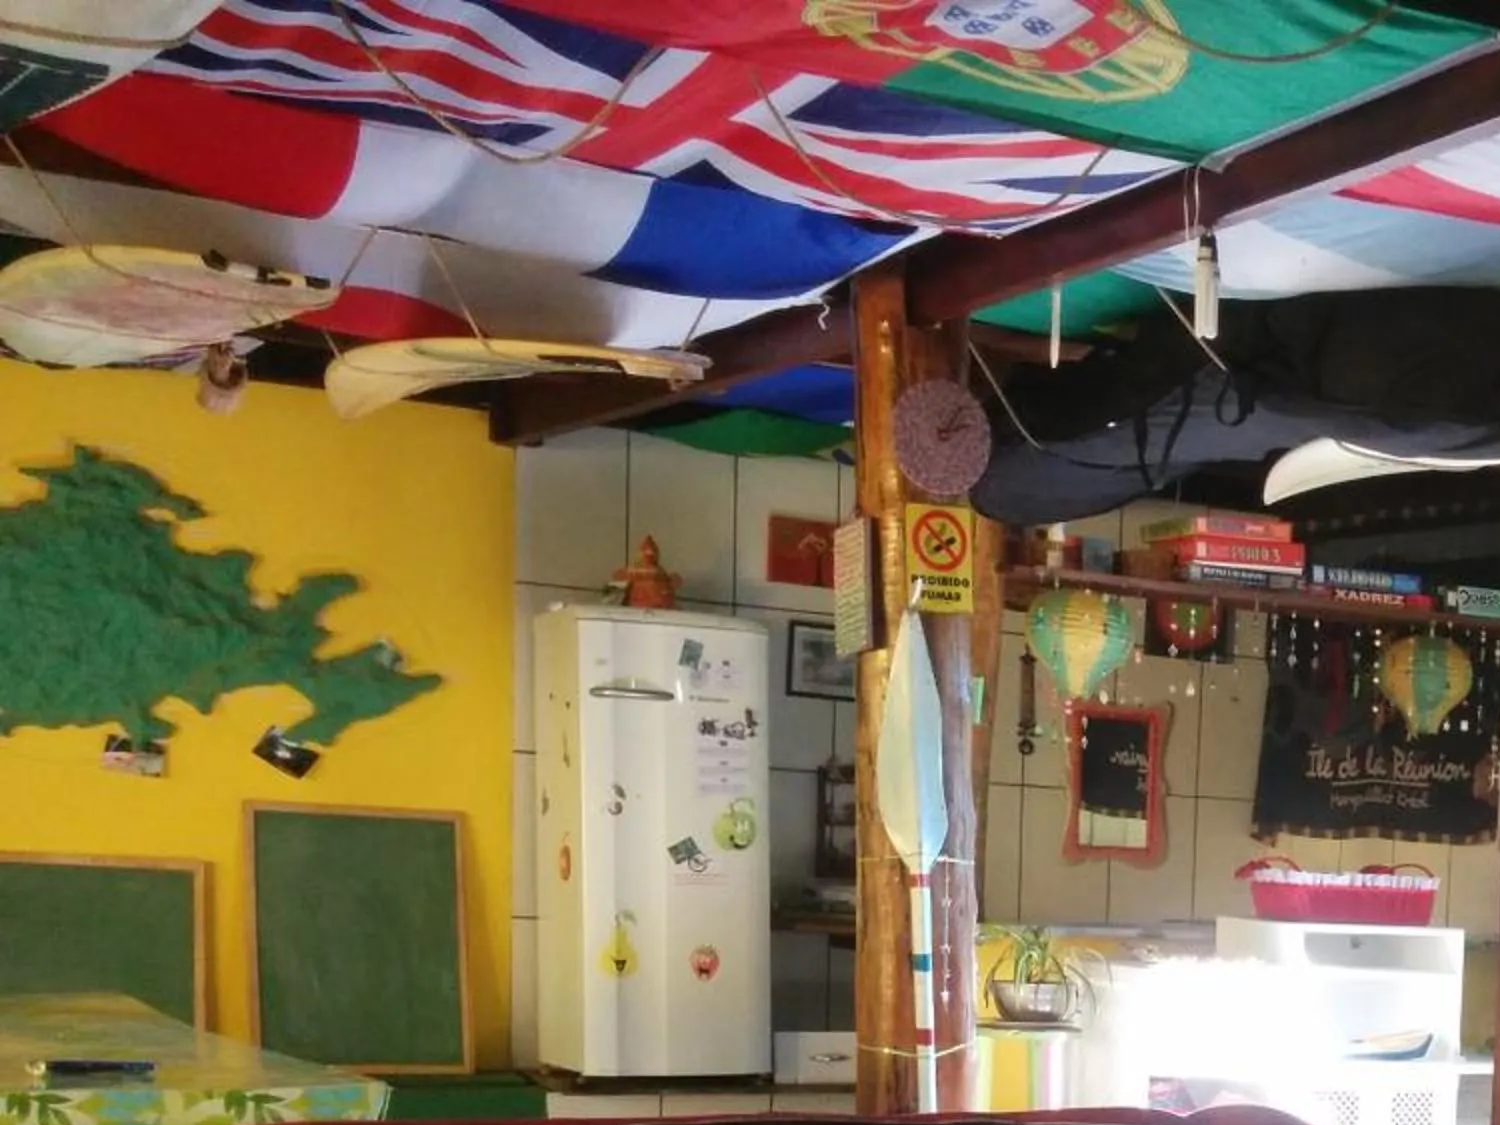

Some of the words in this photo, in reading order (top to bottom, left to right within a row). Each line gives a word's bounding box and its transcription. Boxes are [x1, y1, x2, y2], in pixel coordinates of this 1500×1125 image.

[1333, 588, 1405, 607] XADREZ
[1338, 745, 1360, 778] de
[1365, 745, 1387, 776] la
